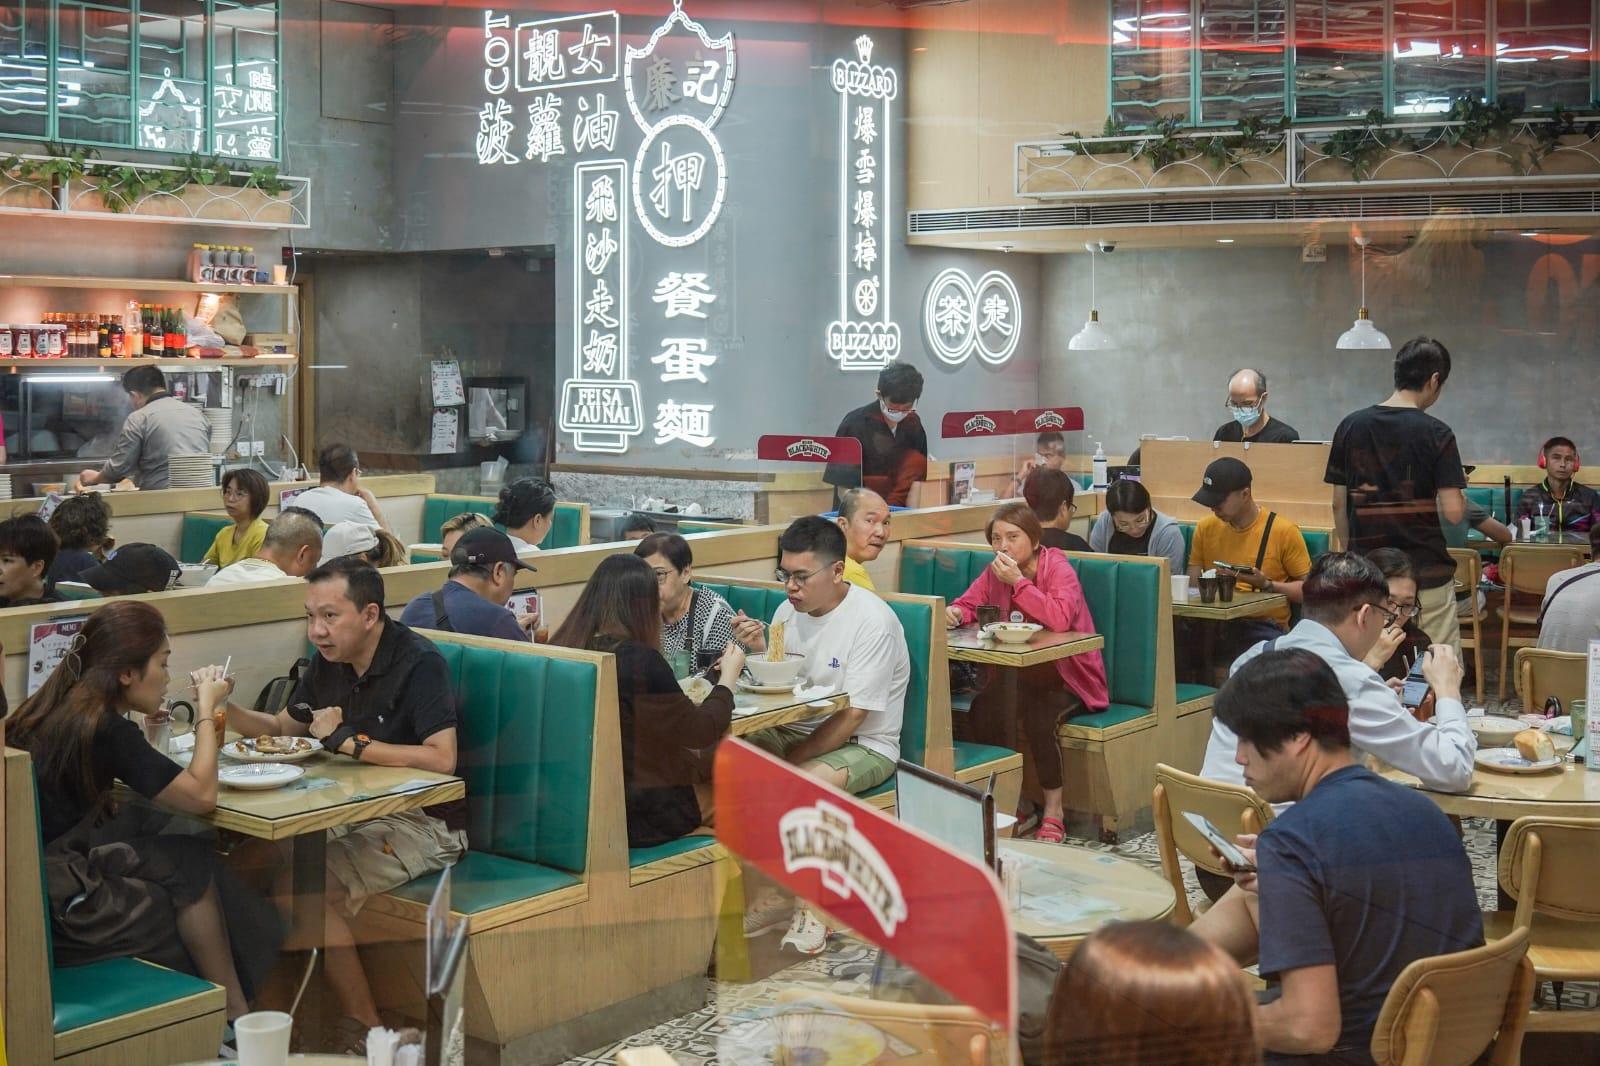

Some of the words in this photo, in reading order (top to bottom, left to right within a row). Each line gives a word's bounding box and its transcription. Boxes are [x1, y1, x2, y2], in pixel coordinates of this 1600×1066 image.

[523, 23, 611, 83] 靚女
[836, 68, 893, 93] BLIZZARD
[476, 92, 619, 164] 菠蘿油
[649, 141, 705, 222] 押
[853, 105, 878, 271] 爆雪爆檸
[583, 174, 619, 376] 飛沙走奶
[651, 271, 717, 448] 餐蛋麵
[832, 333, 897, 350] BLIZZARD
